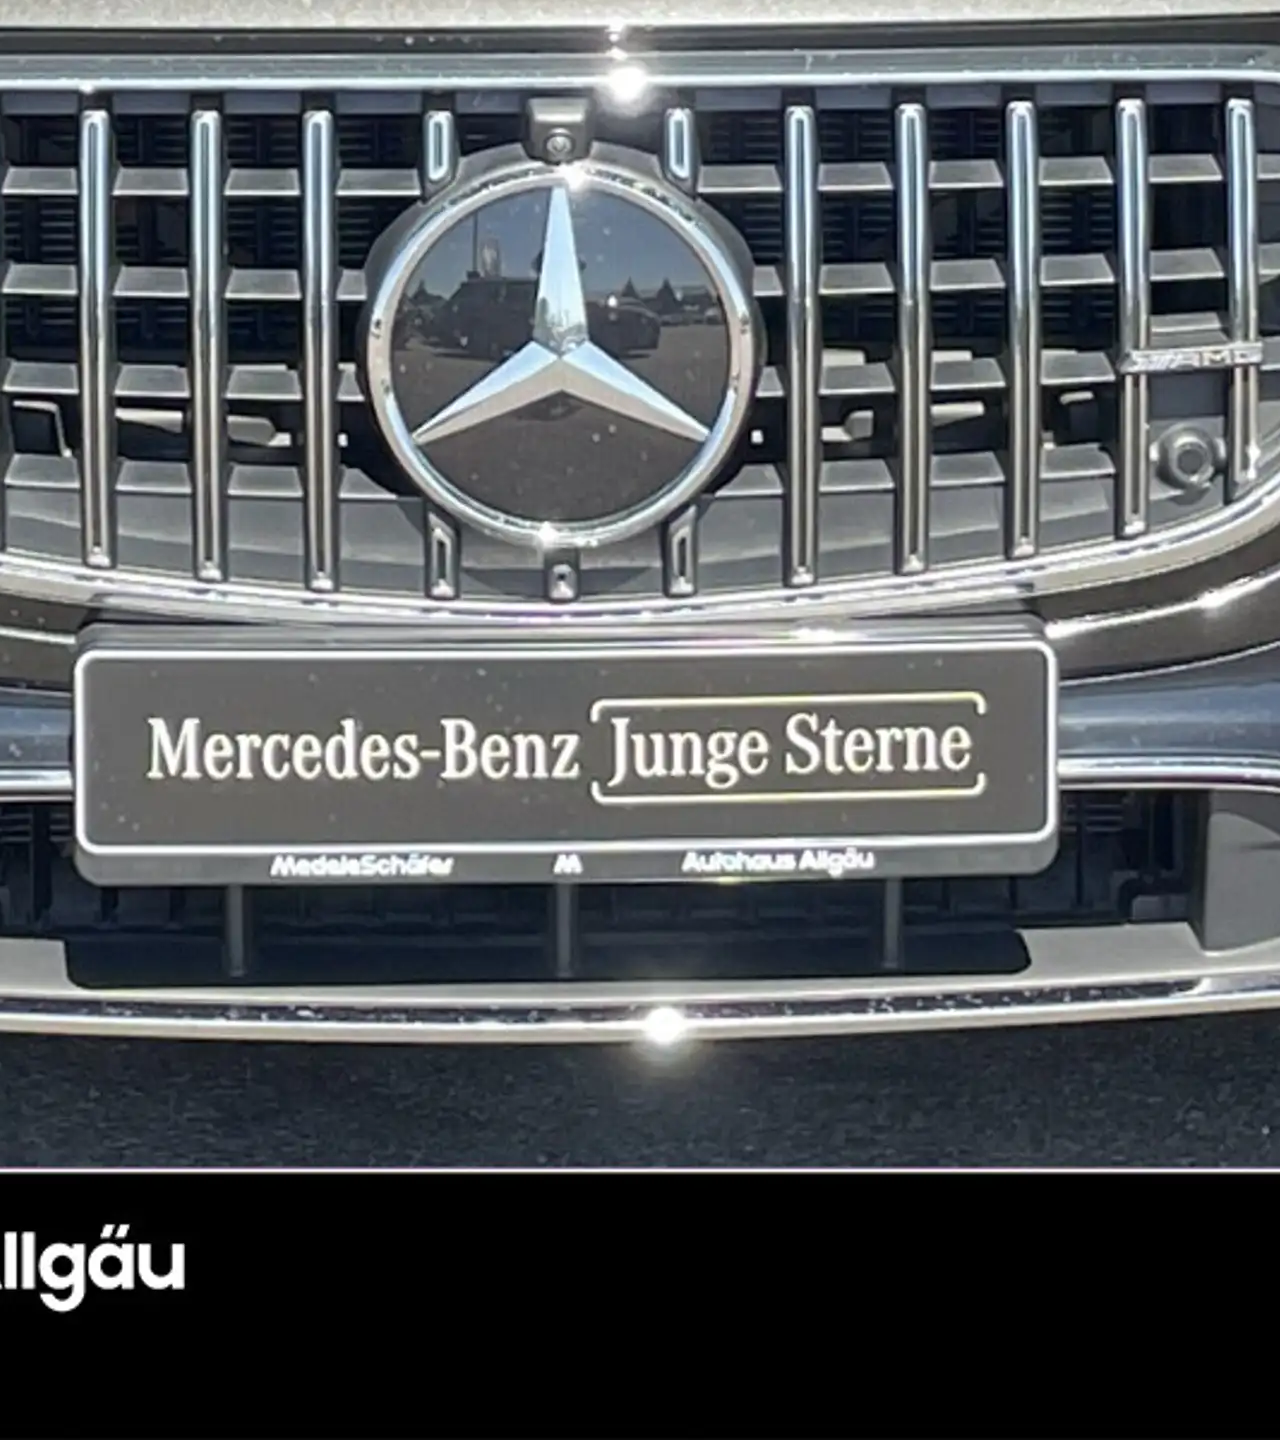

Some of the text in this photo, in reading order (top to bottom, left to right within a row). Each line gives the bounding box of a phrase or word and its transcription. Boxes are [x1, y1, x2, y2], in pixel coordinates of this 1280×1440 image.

[147, 712, 973, 790] Mercedes-Benz Junge Sterne
